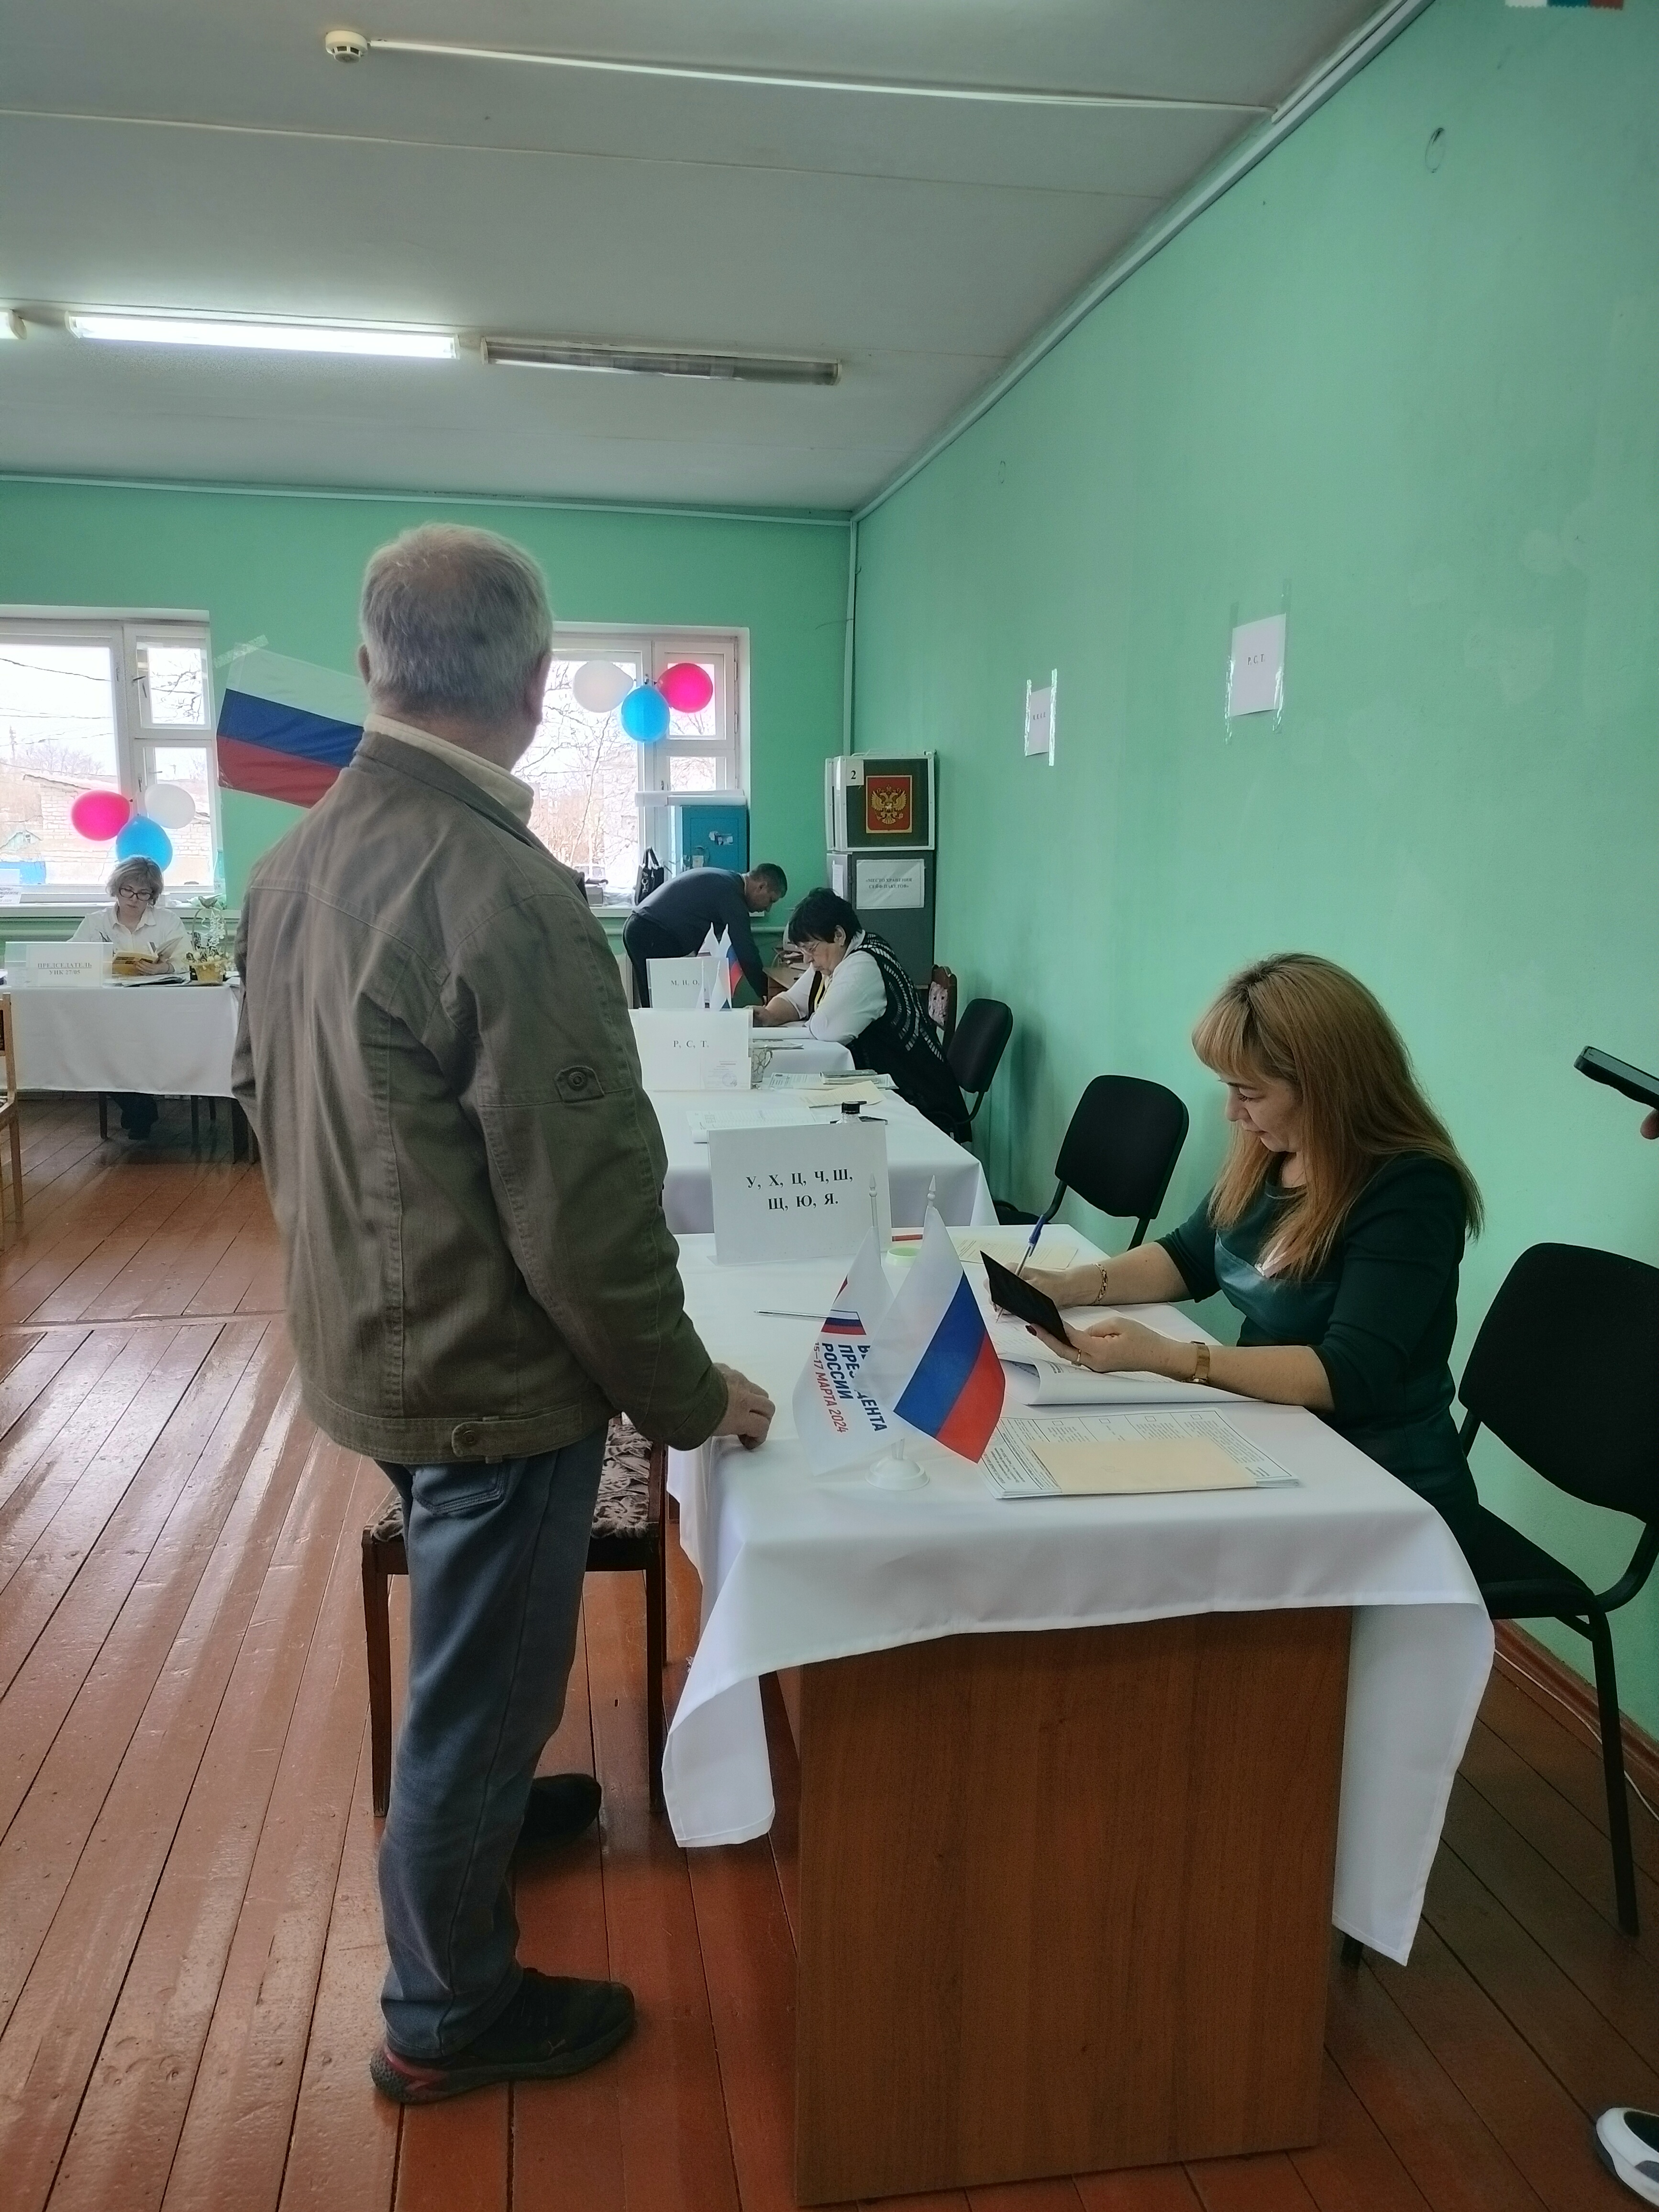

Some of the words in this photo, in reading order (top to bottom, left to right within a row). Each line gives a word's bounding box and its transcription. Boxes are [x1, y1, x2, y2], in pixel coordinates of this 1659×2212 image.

[851, 770, 856, 780] 2
[673, 1040, 682, 1049] Р,
[686, 1040, 696, 1049] С,
[746, 1176, 762, 1190] У,
[768, 1174, 784, 1188] Х,
[791, 1172, 807, 1186] Ц,
[814, 1171, 830, 1184] Ч,
[833, 1168, 853, 1183] Ш,
[768, 1197, 789, 1212] Щ,
[796, 1194, 817, 1209] Ю,
[824, 1193, 839, 1206] Я.
[821, 1342, 854, 1400] РОССИИ
[838, 1343, 888, 1432] ПРЕДЕНТА
[815, 1371, 838, 1407] МАРТА
[829, 1408, 849, 1433] 2024
